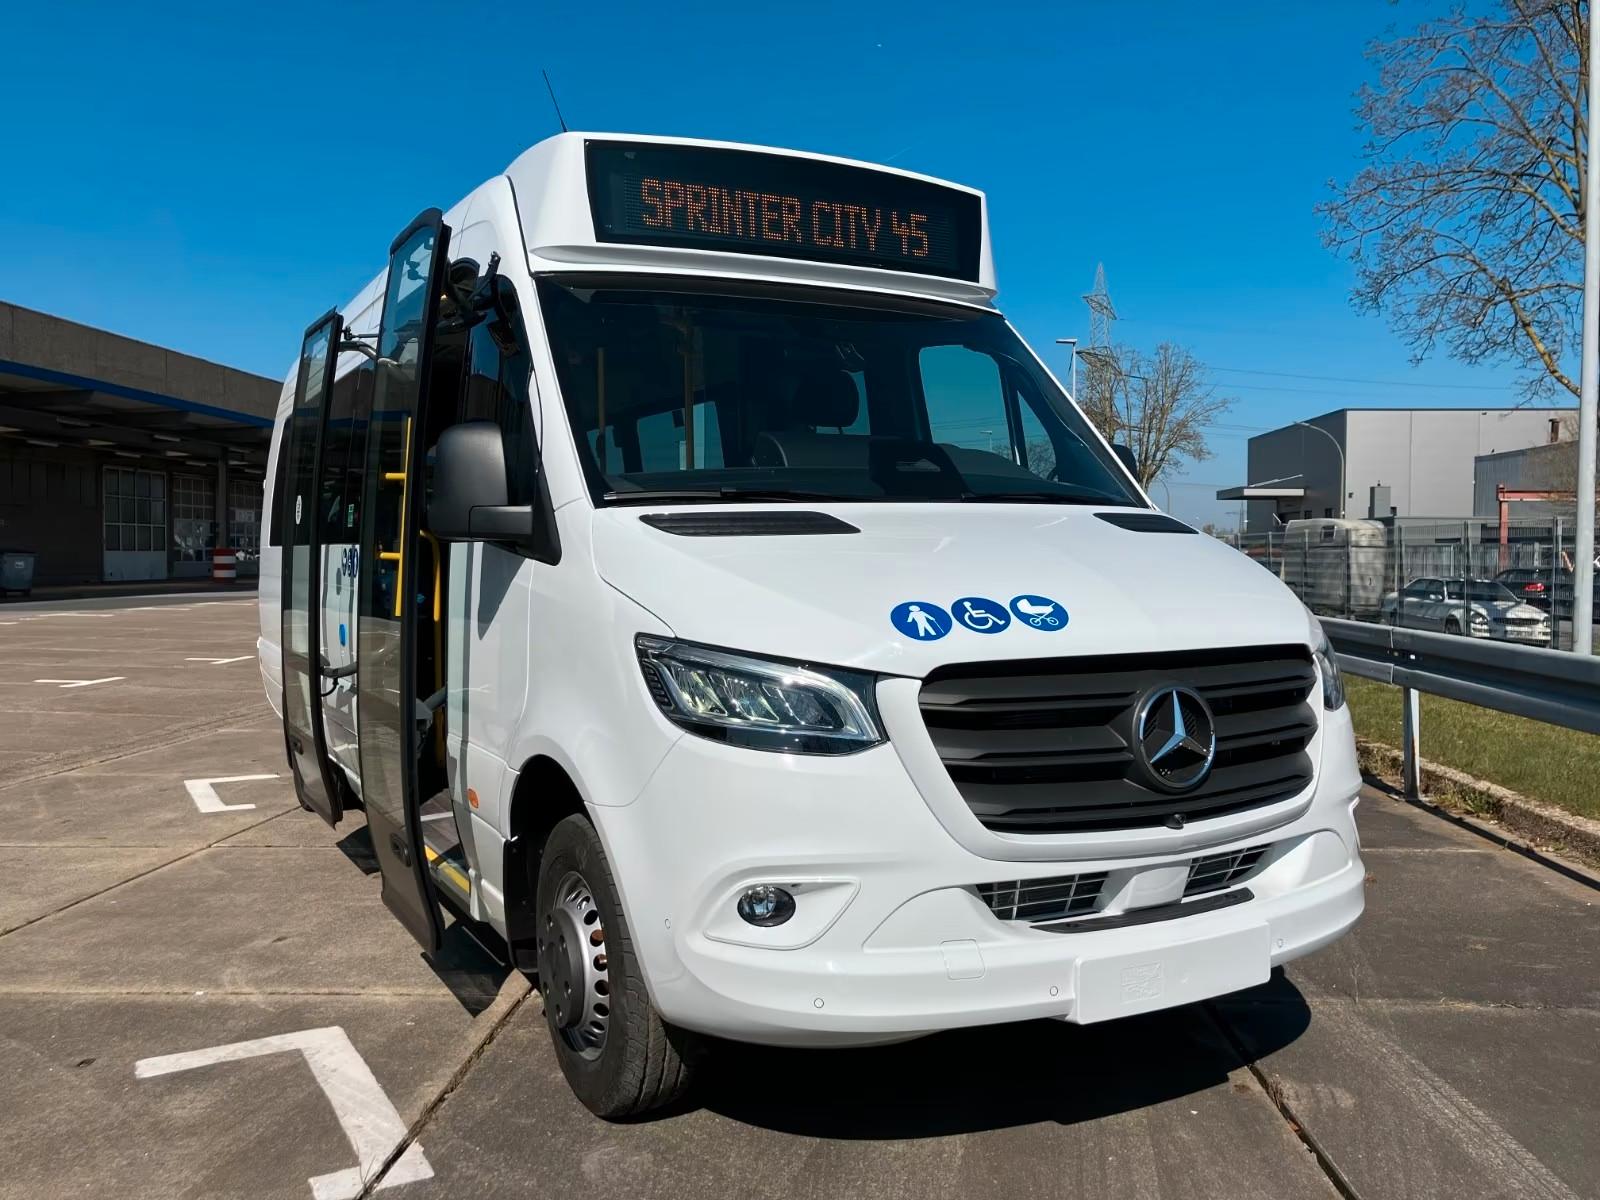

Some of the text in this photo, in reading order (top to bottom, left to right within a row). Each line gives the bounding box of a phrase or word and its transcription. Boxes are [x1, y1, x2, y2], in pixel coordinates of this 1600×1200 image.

[640, 177, 929, 257] SPRINTER CITY 45
